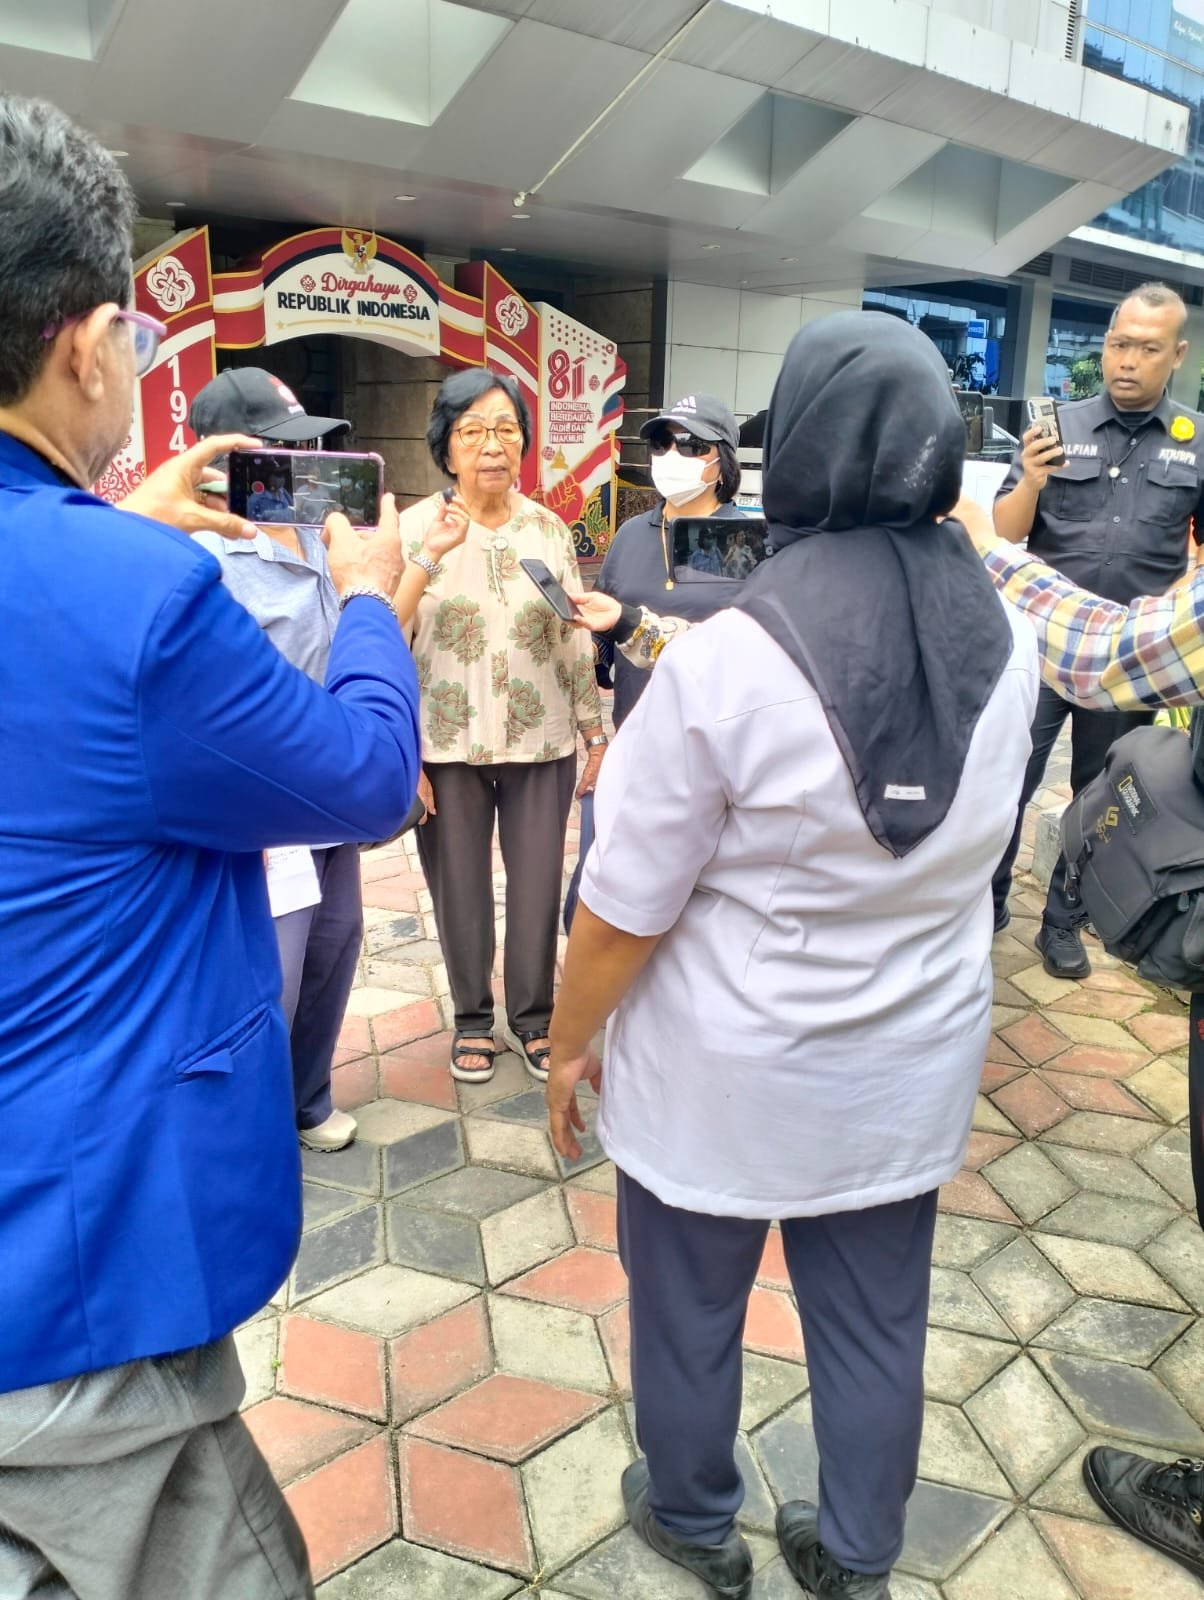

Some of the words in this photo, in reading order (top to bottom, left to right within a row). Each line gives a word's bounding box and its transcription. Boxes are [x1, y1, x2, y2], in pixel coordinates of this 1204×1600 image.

[321, 272, 400, 300] Dirgahayu
[277, 291, 351, 314] REPUBLIK
[357, 300, 431, 321] INDONESIA
[548, 349, 587, 401] 81
[550, 402, 591, 412] INDONESIA
